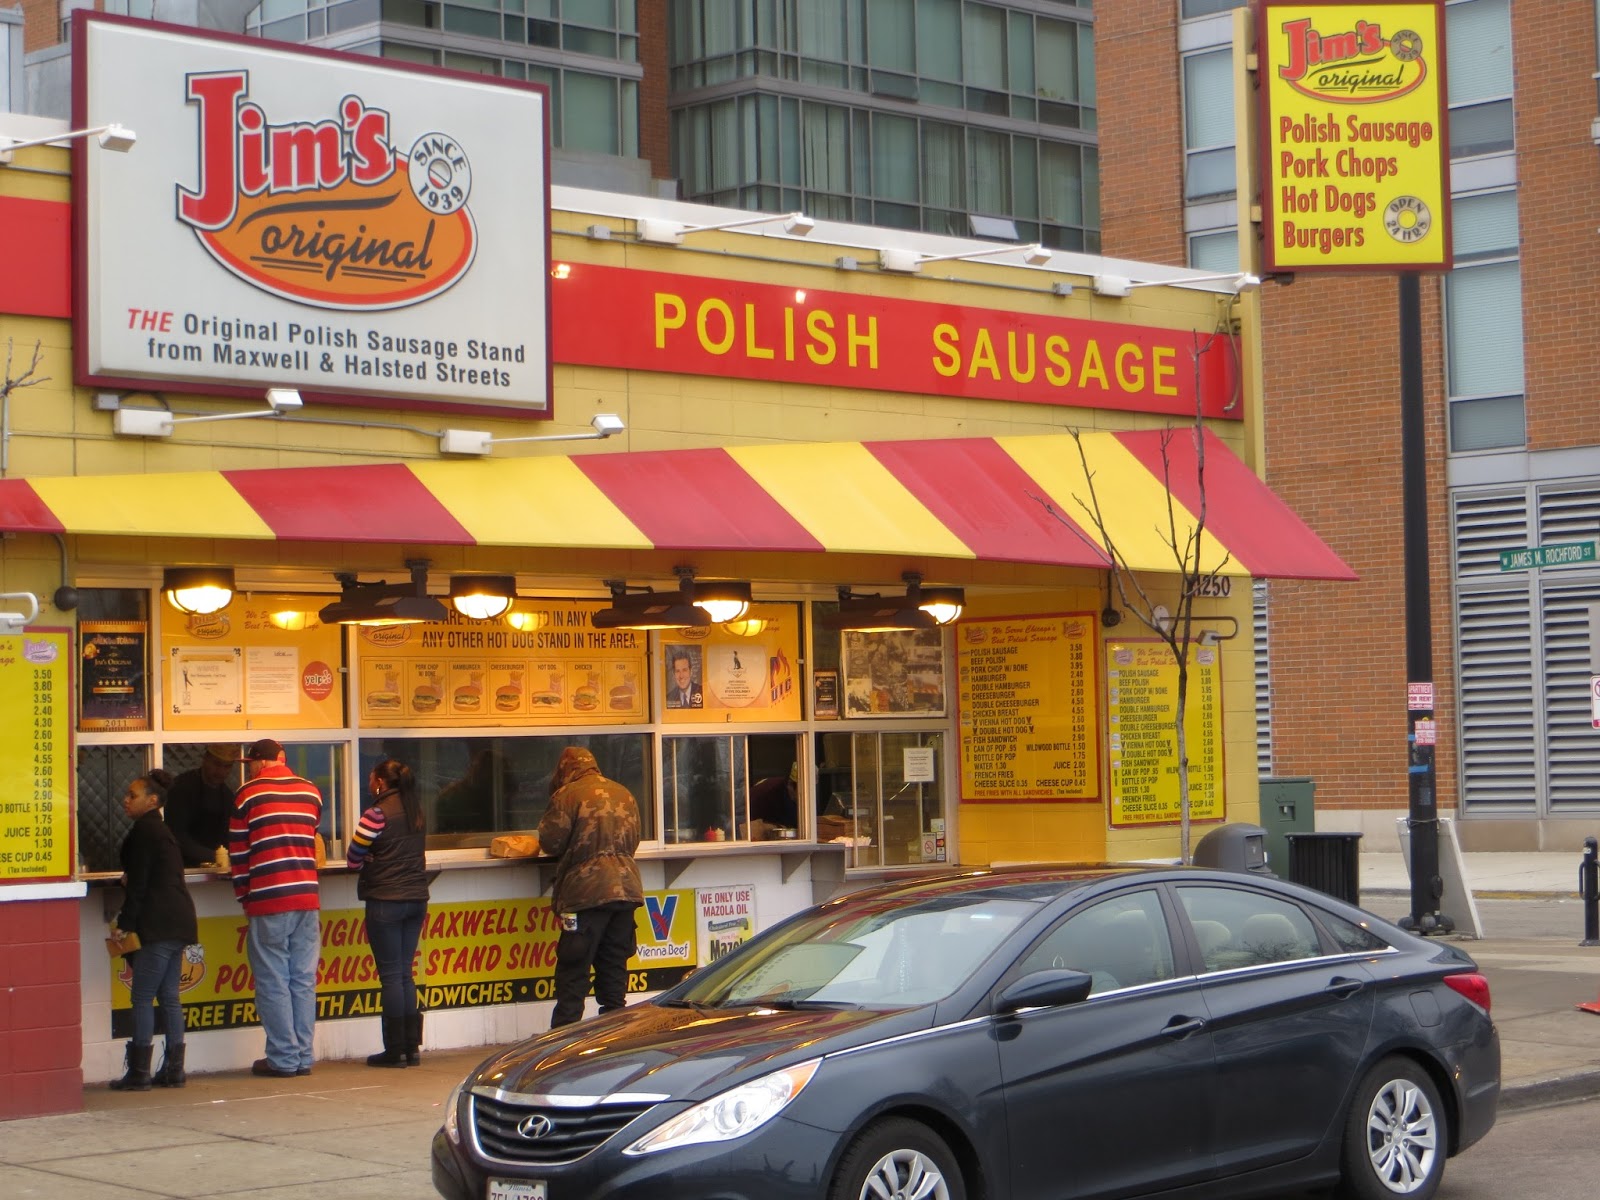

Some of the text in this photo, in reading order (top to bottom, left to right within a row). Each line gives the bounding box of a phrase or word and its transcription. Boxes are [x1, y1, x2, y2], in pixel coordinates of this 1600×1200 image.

[1393, 31, 1419, 43] SINCE
[1278, 17, 1384, 81] Jim's
[1318, 64, 1404, 94] original
[1280, 113, 1433, 148] Polish Sausage
[176, 70, 396, 231] Jim's
[414, 138, 466, 172] SINCE
[1281, 147, 1398, 183] Pork Chops
[419, 182, 463, 210] 1939
[1281, 185, 1376, 218] Hot Dogs
[1390, 198, 1425, 213] OPEN
[1387, 220, 1427, 240] 24 HRS
[1283, 221, 1364, 254] Burgers
[261, 219, 433, 282] original
[128, 309, 525, 364] THE Original Polish Sausage Stand
[655, 292, 1178, 396] POLISH SAUSAGE
[148, 338, 511, 387] from Maxwell & Halsted Streets
[1502, 546, 1591, 568] W JAMES M. ROCHFORD ST
[553, 611, 564, 627] IN
[567, 611, 588, 627] ANY
[373, 628, 406, 643] original
[422, 631, 639, 649] ANY OTHER HOT DOG STAND IN THE AREA.
[970, 648, 991, 656] POLISH
[992, 647, 1018, 655] SAUSAGE
[970, 658, 984, 666] BEEF
[33, 669, 52, 679] 3.50
[971, 666, 986, 674] PORK
[987, 665, 1003, 673] CHOP
[1013, 664, 1029, 672] BONE
[305, 675, 323, 687] yelp
[971, 674, 1007, 682] HAMBURGER
[33, 681, 52, 691] 3.80
[771, 678, 792, 703] UIC
[971, 683, 994, 691] DOUBLE
[995, 681, 1030, 690] HAMBURGER
[33, 693, 52, 703] 3.95
[971, 691, 1016, 700] CHEESEBURGER
[972, 701, 994, 709] DOUBLE
[995, 699, 1040, 708] CHEESEBURGER
[34, 705, 52, 715] 2.40
[972, 709, 997, 718] CHICKEN
[998, 709, 1019, 717] BREAST
[34, 718, 52, 728] 4.30
[34, 730, 52, 740] 2.60
[34, 742, 53, 752] 4.50
[973, 745, 984, 753] CAN
[995, 744, 1006, 752] POP
[1026, 744, 1052, 752] WILDWOOD
[1053, 743, 1071, 751] BOTTLE
[34, 754, 53, 764] 4.55
[1073, 761, 1086, 769] 2.00
[34, 766, 53, 776] 2.60
[34, 779, 53, 788] 4.50
[34, 790, 53, 800] 2.90
[5, 802, 53, 813] BOTTLE 1.50
[1122, 803, 1157, 812] CHEESE SLICE
[34, 815, 53, 824] 1.75
[4, 827, 52, 837] JUICE 2.00
[34, 839, 53, 848] 1.30
[15, 852, 52, 863] CUP 0.45
[8, 866, 20, 874] (Tax
[700, 890, 750, 905] WE ONLY USE
[703, 903, 748, 917] MAZOLA OIL
[637, 943, 688, 957] Vienna Beef
[711, 938, 743, 961] Mazo
[425, 944, 502, 976] STAND
[506, 940, 558, 970] SINC
[317, 994, 345, 1017] TH
[349, 992, 384, 1015] ALL
[416, 982, 513, 1009] NDWICHES
[627, 972, 648, 992] RS
